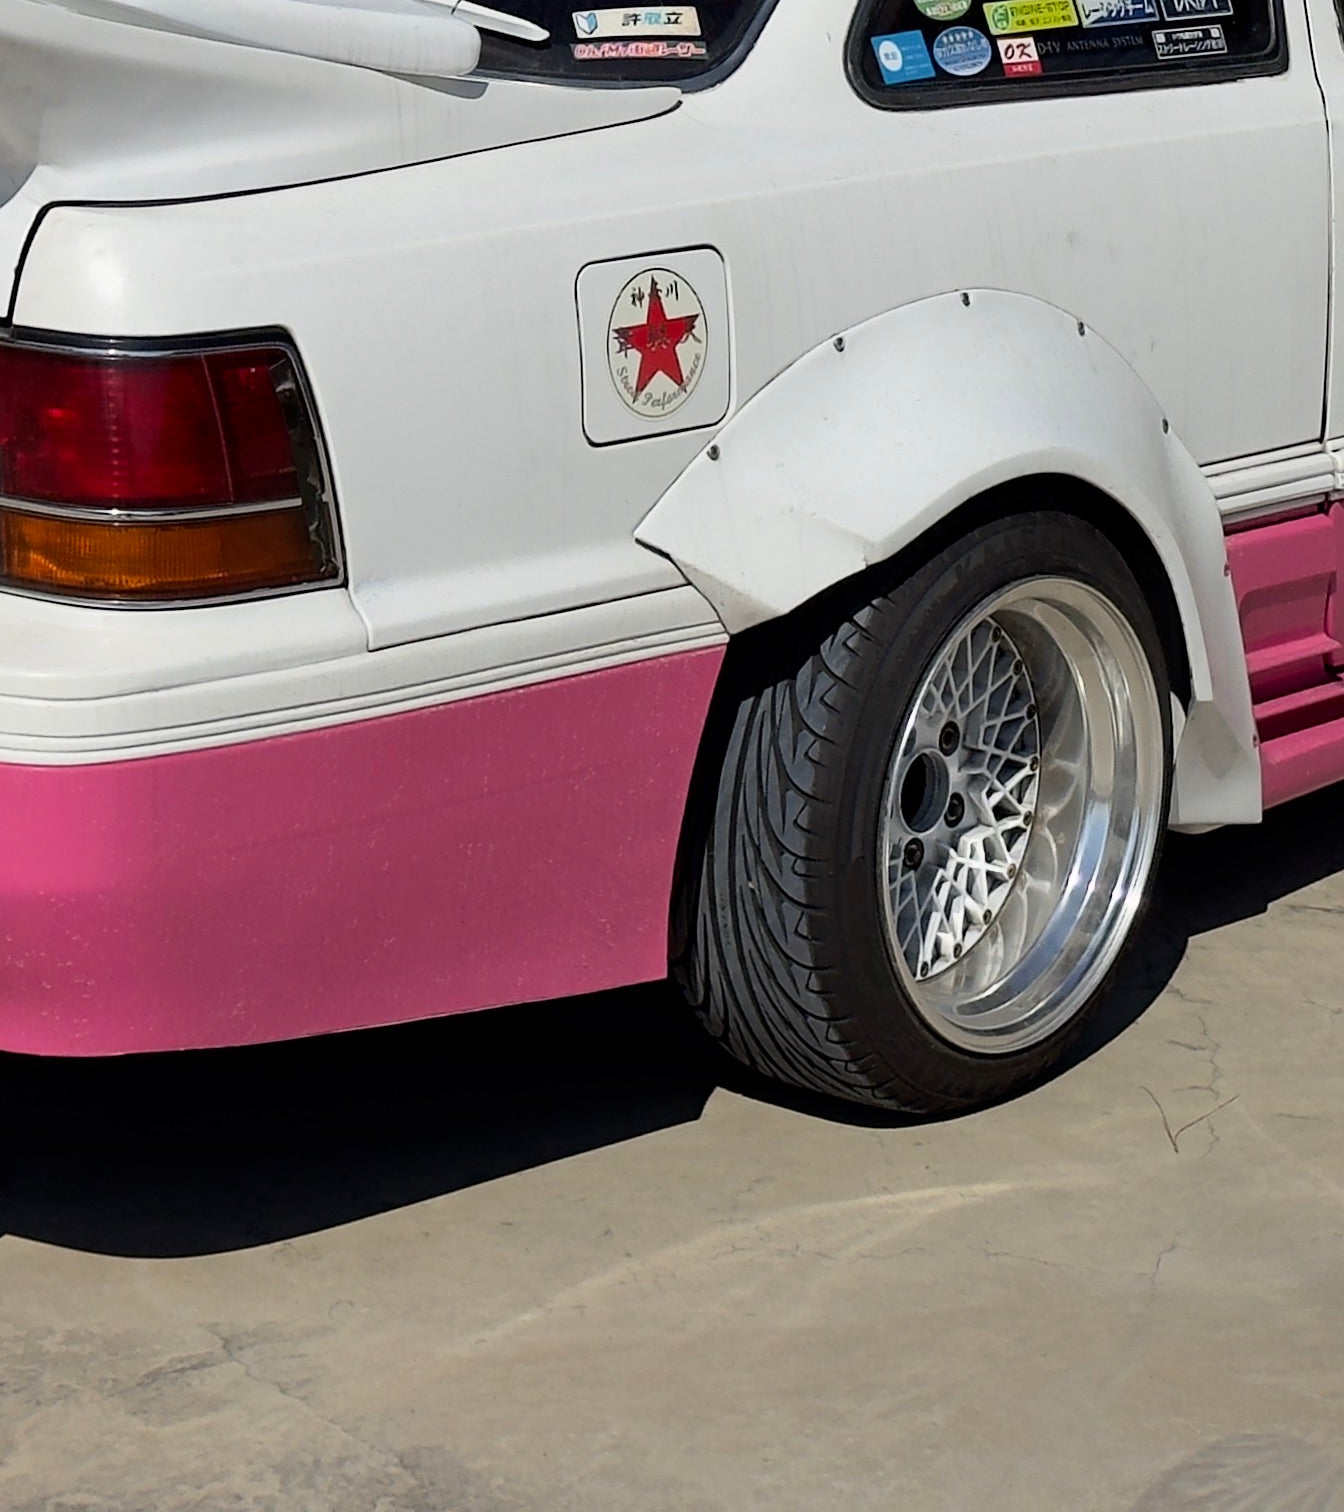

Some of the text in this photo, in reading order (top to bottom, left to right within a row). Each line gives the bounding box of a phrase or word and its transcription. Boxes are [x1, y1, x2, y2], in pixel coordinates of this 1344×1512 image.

[1004, 42, 1034, 60] OK
[1066, 38, 1110, 52] ANTENNA
[1112, 35, 1145, 48] SYSTEM
